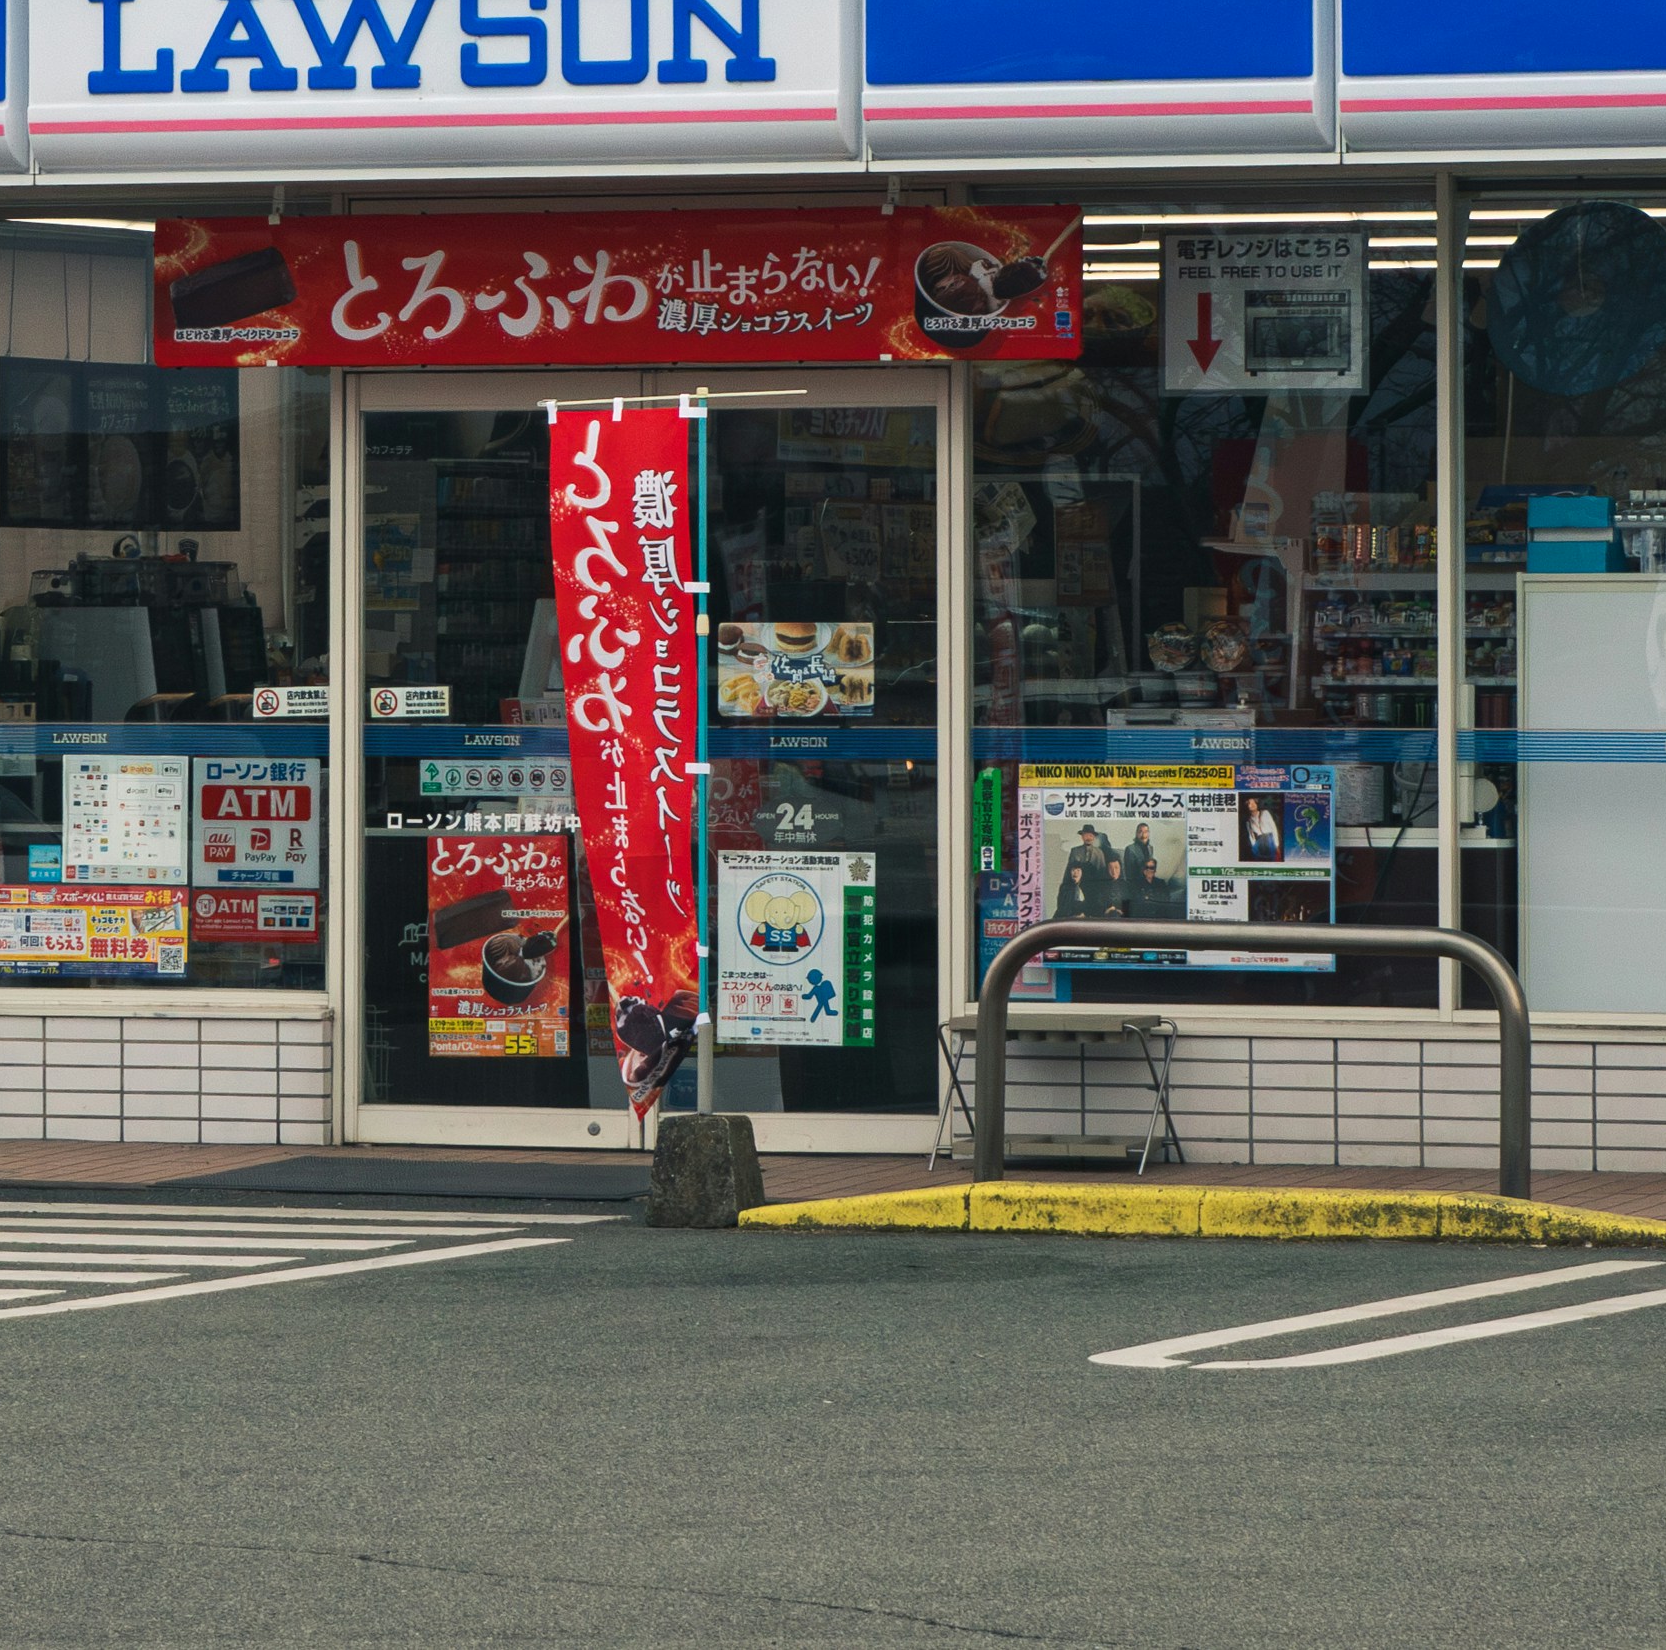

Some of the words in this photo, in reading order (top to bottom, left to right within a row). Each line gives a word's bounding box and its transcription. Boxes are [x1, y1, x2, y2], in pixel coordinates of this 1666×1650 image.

[1177, 238, 1351, 259] 電子レンジはこちら
[1179, 266, 1216, 279] FEEL
[1221, 265, 1260, 278] FREE
[1265, 265, 1286, 278] TO
[1291, 265, 1323, 278] USE
[1327, 265, 1341, 277] IT
[656, 297, 874, 337] 濃厚ショコラスイーツ
[925, 317, 1036, 331] とろける濃厚レアショコラ
[174, 327, 300, 342] ほどける濃厚ベイクドショコラ
[286, 690, 328, 700] 店内飲食禁止
[405, 691, 445, 700] 店内飲食禁止
[52, 733, 108, 744] LAWSON
[464, 735, 521, 746] LAWSON
[769, 736, 828, 748] LAWSON
[1190, 738, 1250, 749] LAWSON
[207, 762, 307, 782] ローソン銀行
[1035, 766, 1062, 778] NIKO
[1064, 766, 1091, 778] NIKO
[1093, 766, 1114, 778] TAN
[1116, 766, 1137, 778] TAN
[1138, 768, 1177, 780] presents
[1178, 766, 1233, 779] 「2525の日」
[217, 788, 296, 818] ATM
[1065, 792, 1185, 808] サザンオールスターズ
[1188, 792, 1237, 806] 中村佳穂
[776, 803, 815, 830] 24
[815, 813, 839, 821] HOURS
[1065, 810, 1078, 818] LIVE
[1079, 810, 1095, 818] TOUR
[1096, 810, 1111, 818] 2025
[387, 812, 581, 833] ローソン熊本阿蘇坊中
[1020, 813, 1033, 840] ボス
[208, 831, 232, 844] au
[774, 832, 818, 844] 年中無休
[209, 845, 231, 858] PAY
[244, 851, 277, 864] PayPay
[285, 851, 307, 864] Pay
[722, 854, 840, 867] セーフティステーション活動実施店
[231, 871, 280, 881] チャージ可能
[503, 872, 565, 892] 止まらない!
[756, 877, 779, 890] SAFETY
[780, 877, 806, 890] STATION
[1201, 880, 1234, 893] DEEN
[217, 899, 255, 913] ATM
[770, 930, 792, 942] SS
[45, 934, 84, 951] もらえる
[90, 936, 149, 958] 無料券
[731, 994, 746, 1004] 110
[755, 994, 771, 1004] 119
[458, 1000, 548, 1017] 濃厚ショコラスイーツ
[430, 1041, 474, 1052] Pontaパス
